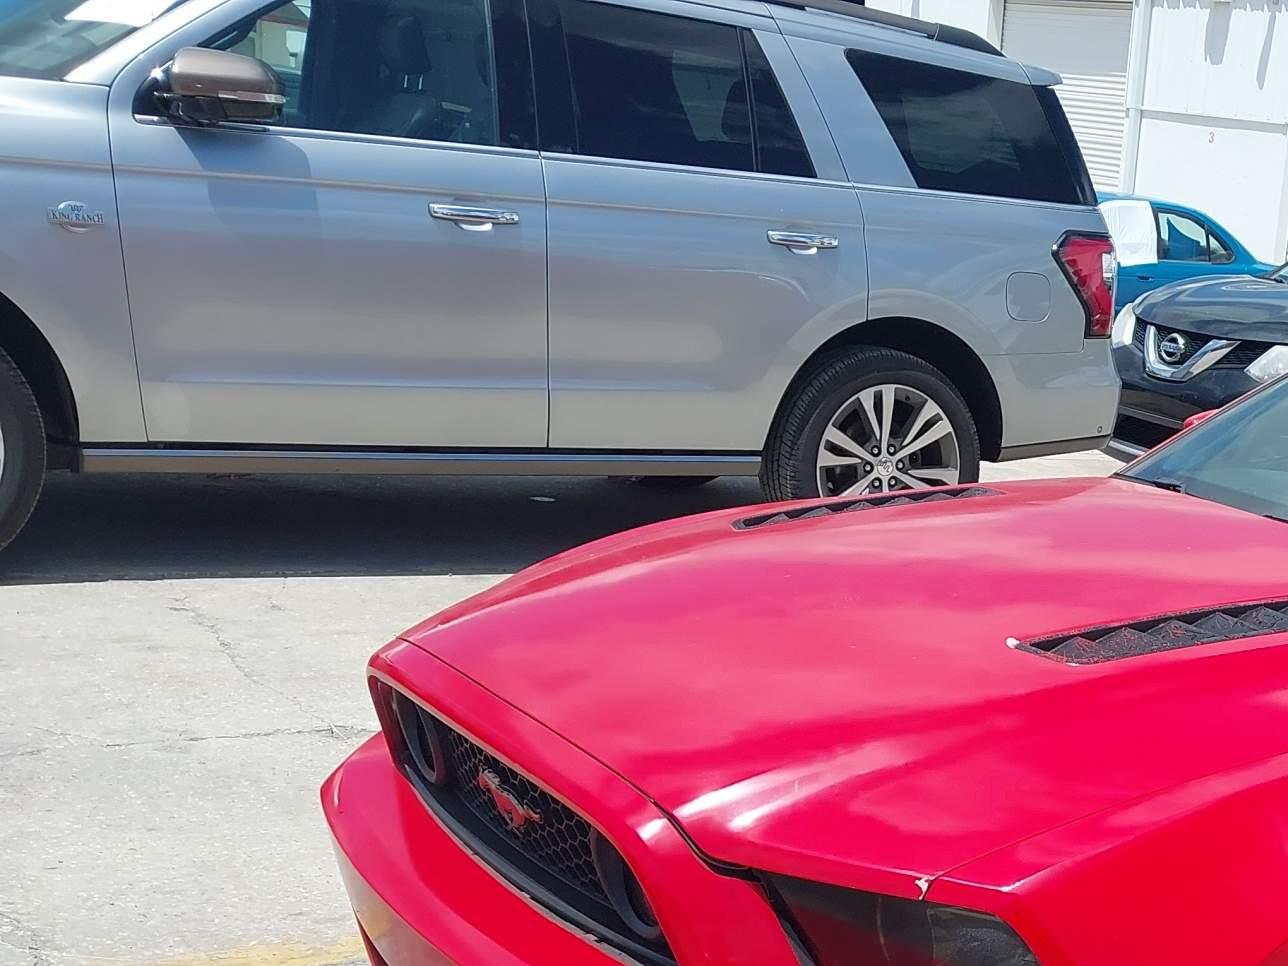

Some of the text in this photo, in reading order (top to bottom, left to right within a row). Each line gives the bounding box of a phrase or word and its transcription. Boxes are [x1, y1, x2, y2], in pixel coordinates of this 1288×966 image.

[1208, 131, 1215, 144] 3
[51, 209, 104, 224] KING RANCH
